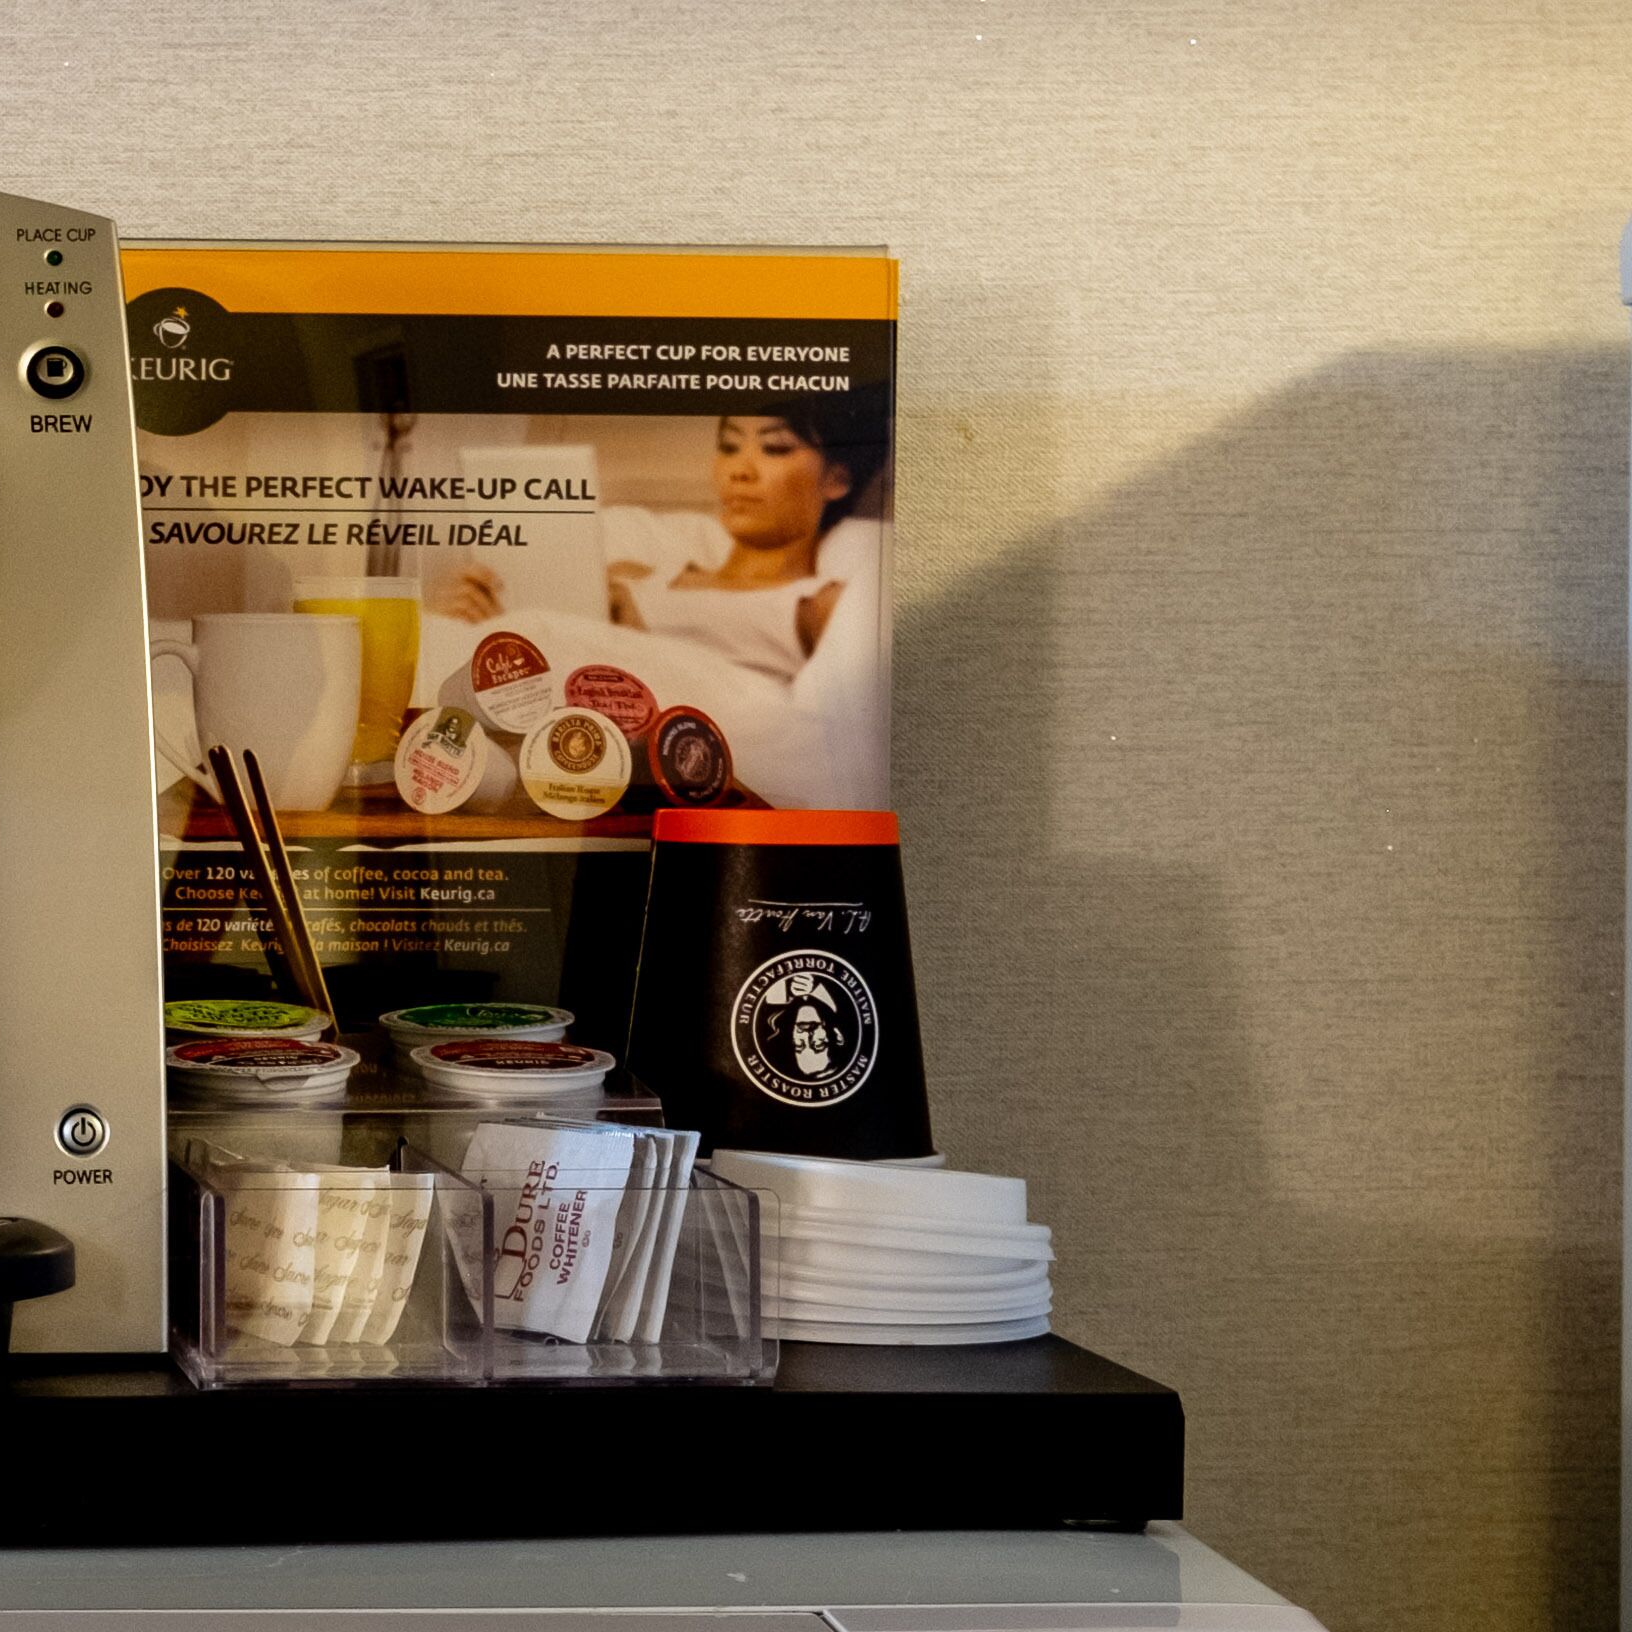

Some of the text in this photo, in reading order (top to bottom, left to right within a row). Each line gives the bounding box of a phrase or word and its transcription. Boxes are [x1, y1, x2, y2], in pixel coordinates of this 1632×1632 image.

[16, 228, 97, 242] PLACE CUP
[24, 281, 93, 295] HEATING
[546, 344, 850, 363] A PERFECT CUP FOR EVERYONE
[497, 373, 850, 392] UNE TASSE PARFAITE POUR CHACUN
[30, 414, 93, 433] BREW
[180, 476, 237, 498] THE
[245, 476, 373, 499] PERFECT
[378, 477, 519, 500] WAKE-UP
[524, 478, 596, 500] CALL
[149, 516, 528, 547] SAVOUREZ LE RÉVEIL IDÉAL
[162, 866, 200, 880] Over
[206, 866, 236, 881] 120
[314, 866, 331, 883] of
[334, 866, 389, 885] coffee,
[393, 868, 439, 881] cocoa
[443, 867, 474, 882] and
[478, 868, 509, 882] tea.
[174, 886, 236, 900] Choose
[303, 888, 319, 900] at
[324, 887, 374, 900] home!
[378, 887, 416, 900] Visit
[420, 886, 496, 903] Keurig.ca
[176, 918, 194, 932] de
[196, 918, 221, 932] 120
[350, 918, 417, 932] chocolats
[421, 918, 470, 932] chauds
[474, 919, 489, 932] et
[493, 917, 528, 933] thés.
[328, 938, 379, 951] maison
[392, 938, 442, 951] Visitez
[443, 938, 511, 955] Keurig.ca
[747, 1054, 869, 1099] MASTER ROASTER
[52, 1169, 113, 1185] POWER
[513, 1161, 560, 1302] FOODS LTD.
[549, 1202, 571, 1271] COFFEE
[556, 1189, 588, 1285] WHITENER
